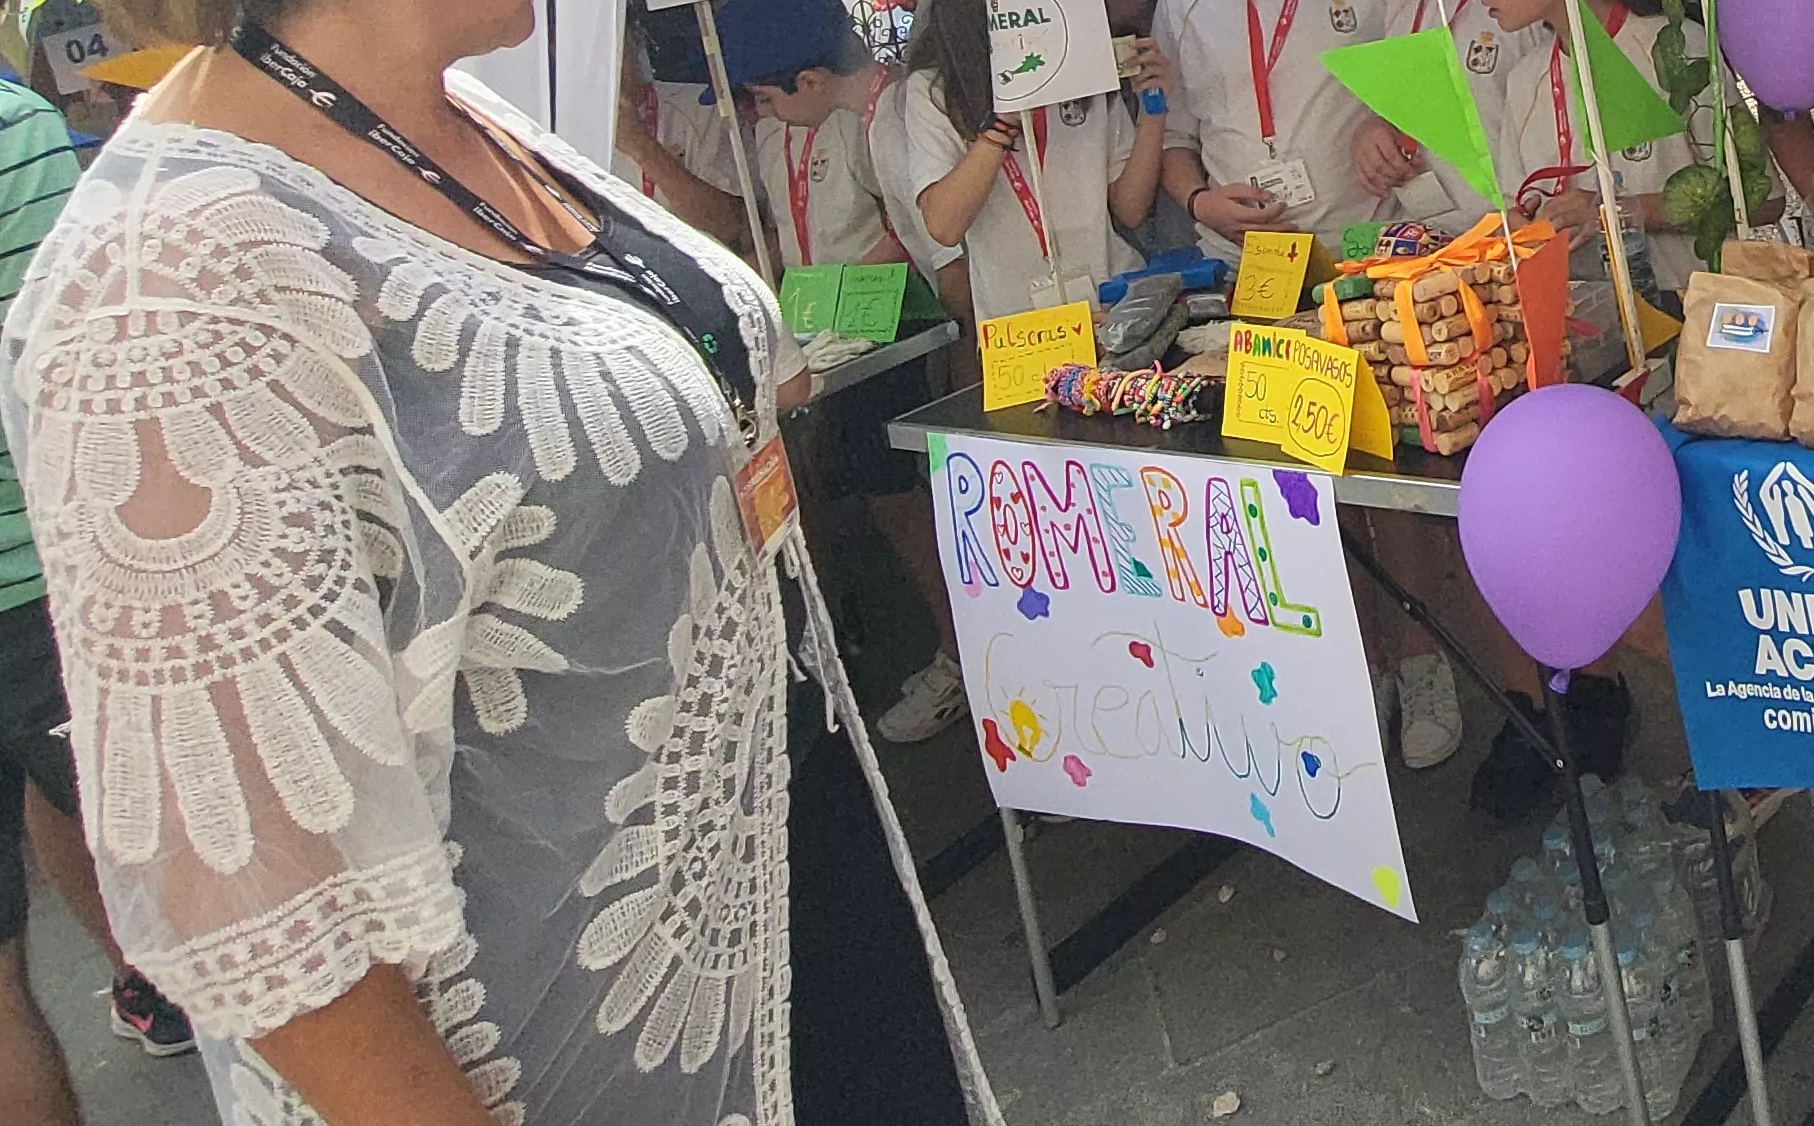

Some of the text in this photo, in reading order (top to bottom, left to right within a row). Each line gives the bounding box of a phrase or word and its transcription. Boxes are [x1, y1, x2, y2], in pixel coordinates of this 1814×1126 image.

[65, 34, 109, 63] 04
[1242, 274, 1275, 302] 3€
[996, 364, 1025, 390] 50
[1293, 340, 1354, 388] POSAVASOS
[1243, 370, 1267, 401] 50
[946, 451, 1323, 638] ROMERAL
[1705, 681, 1724, 698] La
[1728, 681, 1781, 700] Agencia
[1783, 684, 1800, 700] de
[1800, 686, 1814, 703] la
